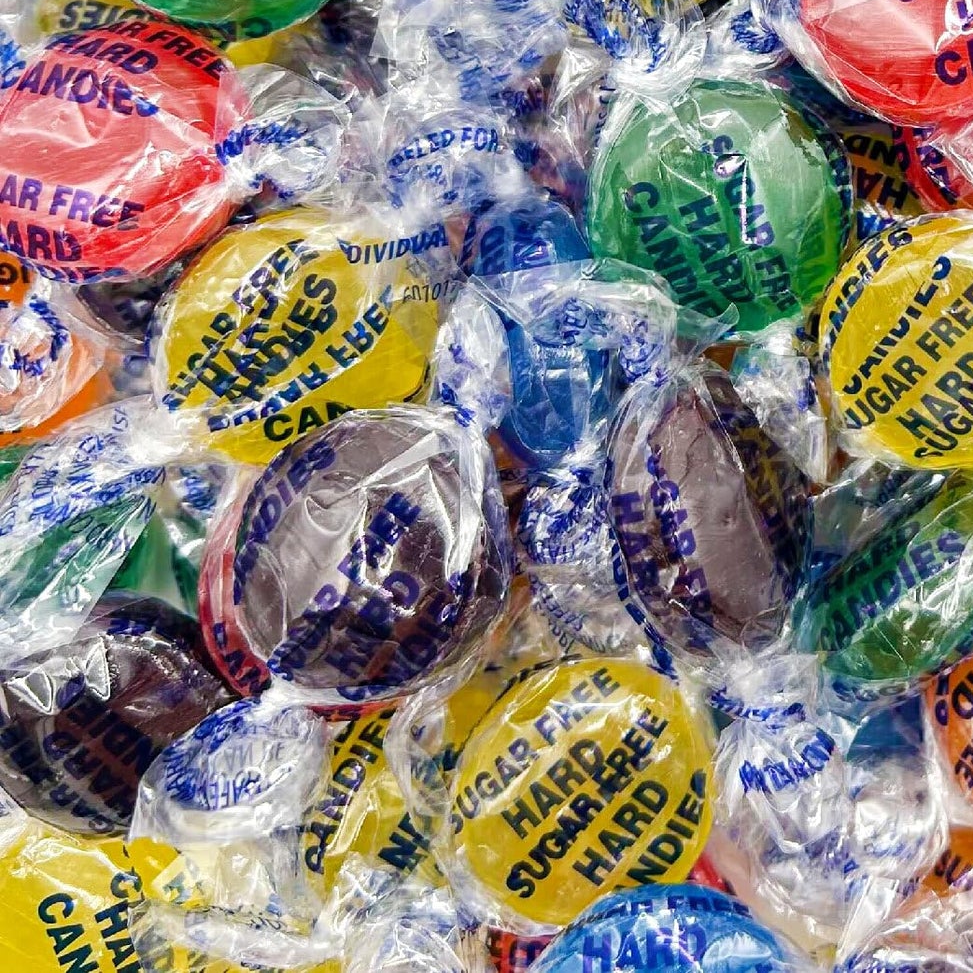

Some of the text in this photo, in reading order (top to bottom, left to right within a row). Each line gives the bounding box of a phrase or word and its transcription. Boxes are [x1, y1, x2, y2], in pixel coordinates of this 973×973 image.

[5, 226, 82, 262] ARD
[625, 181, 722, 315] CANDIE
[679, 196, 757, 304] HARD
[501, 737, 605, 839] HARD
[572, 779, 669, 887] HARD
[622, 768, 708, 887] NDIES
